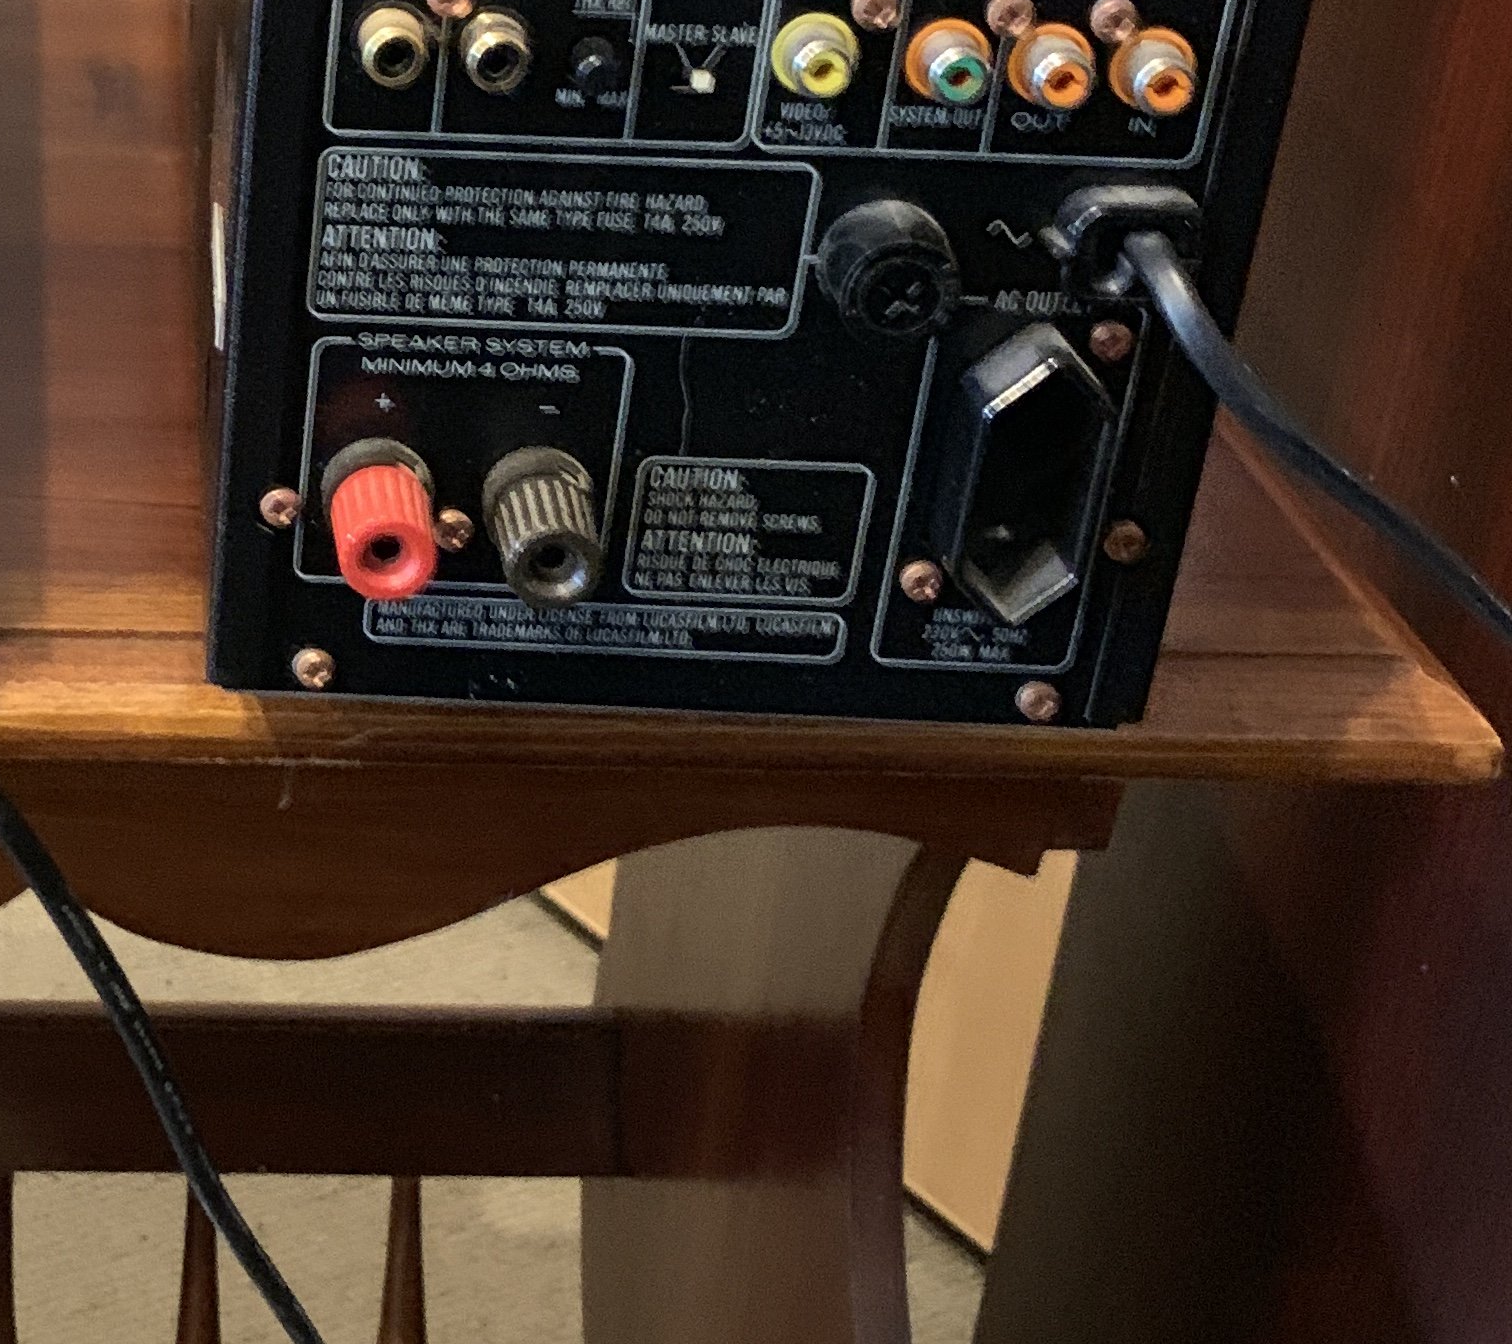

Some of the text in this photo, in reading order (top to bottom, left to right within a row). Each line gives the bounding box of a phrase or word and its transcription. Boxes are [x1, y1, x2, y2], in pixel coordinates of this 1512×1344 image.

[644, 23, 708, 45] MASTER
[1011, 111, 1070, 133] OUT
[1127, 117, 1156, 138] IN
[357, 183, 443, 205] CONTINUED
[445, 186, 536, 209] PROTECTION
[539, 190, 604, 211] AGAINST
[324, 201, 388, 223] REPLACE
[435, 205, 476, 225] WITH
[478, 207, 506, 227] THE
[509, 209, 550, 230] SAME
[474, 256, 567, 278] PROTECTION
[994, 289, 1024, 313] AC
[357, 331, 591, 359] SPEAKER SYSTEM
[361, 356, 581, 384] MINIMUM 4 OHMS
